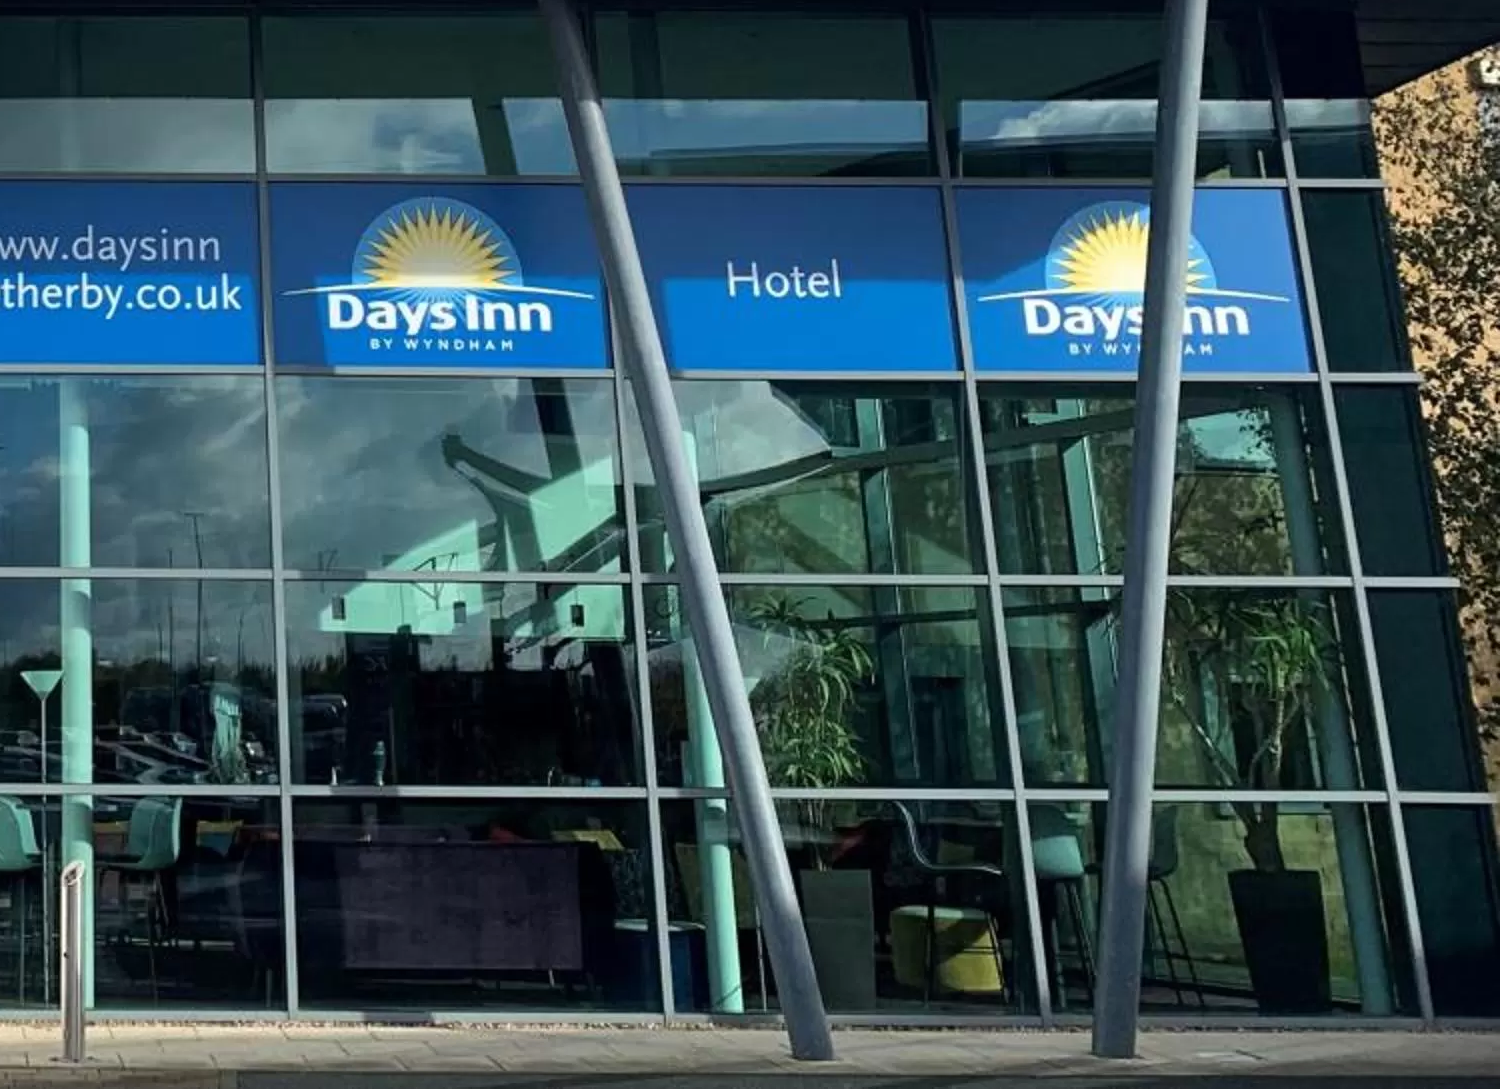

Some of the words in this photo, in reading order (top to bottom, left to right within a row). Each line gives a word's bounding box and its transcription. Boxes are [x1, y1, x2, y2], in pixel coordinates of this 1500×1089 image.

[726, 258, 842, 299] Hotel
[327, 293, 457, 336] Days
[464, 294, 552, 332] Inn
[1183, 305, 1250, 336] nn
[369, 338, 393, 351] BY
[403, 339, 514, 352] WYNDHAM
[1068, 342, 1093, 356] BY
[1102, 342, 1213, 356] WYAM
